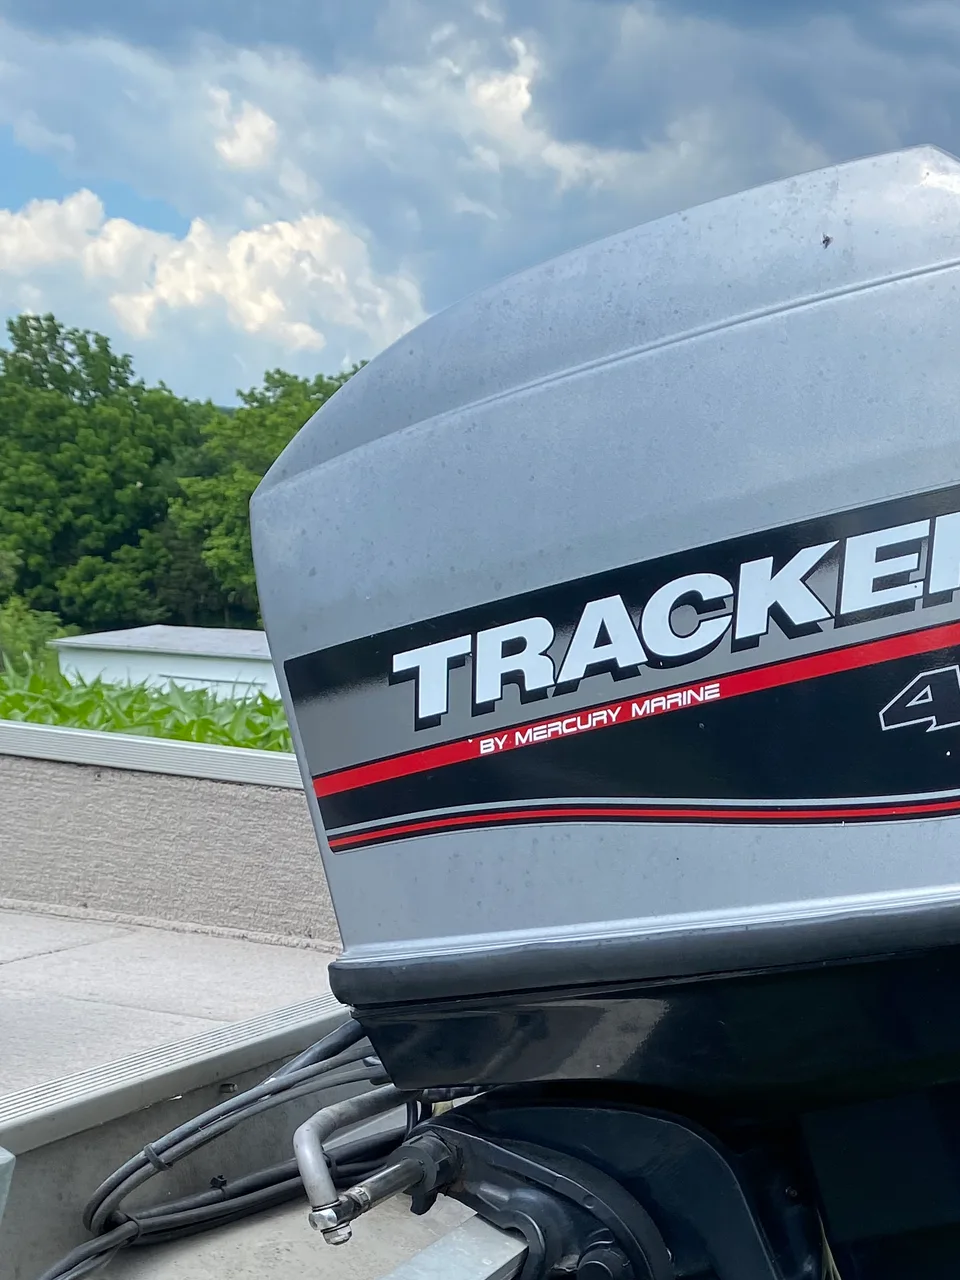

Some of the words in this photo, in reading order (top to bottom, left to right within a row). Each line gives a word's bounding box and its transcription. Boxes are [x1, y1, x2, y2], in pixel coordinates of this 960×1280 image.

[480, 734, 508, 754] BY
[515, 706, 622, 745] MERCURY
[631, 683, 720, 718] MARINE
